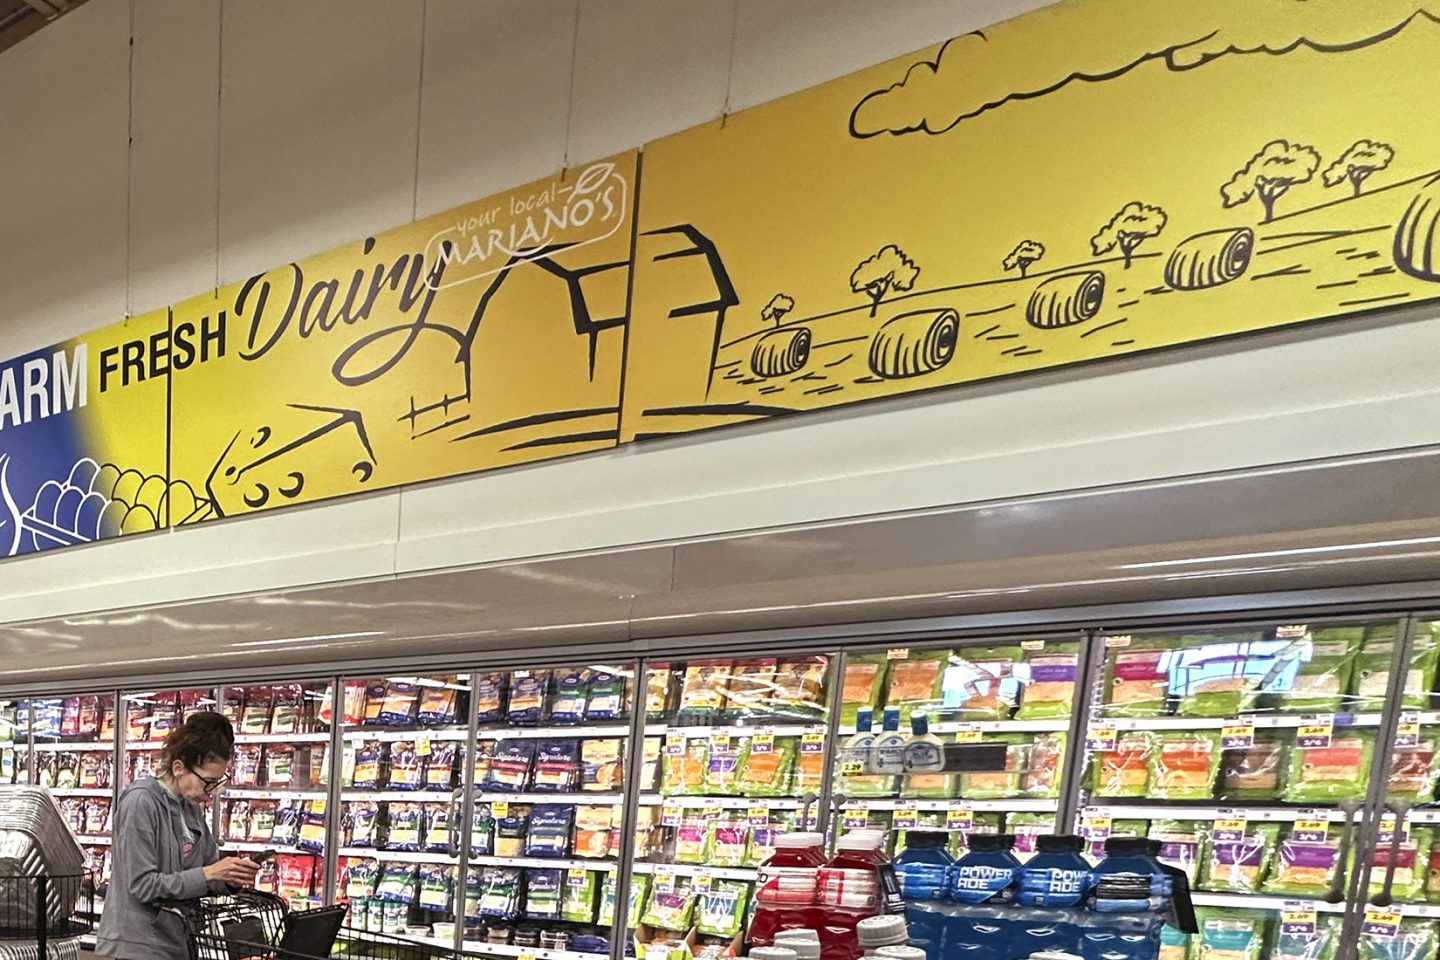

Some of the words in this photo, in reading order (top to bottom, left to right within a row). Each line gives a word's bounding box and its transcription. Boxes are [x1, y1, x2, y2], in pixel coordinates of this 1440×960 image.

[457, 206, 501, 237] your
[510, 182, 556, 216] local
[435, 186, 614, 273] MARIANO'S
[99, 310, 227, 394] FRESH
[234, 237, 465, 387] Dairy
[531, 816, 567, 826] Signature
[959, 866, 1013, 879] POWER
[958, 879, 989, 890] ADE
[1049, 882, 1081, 893] ADE
